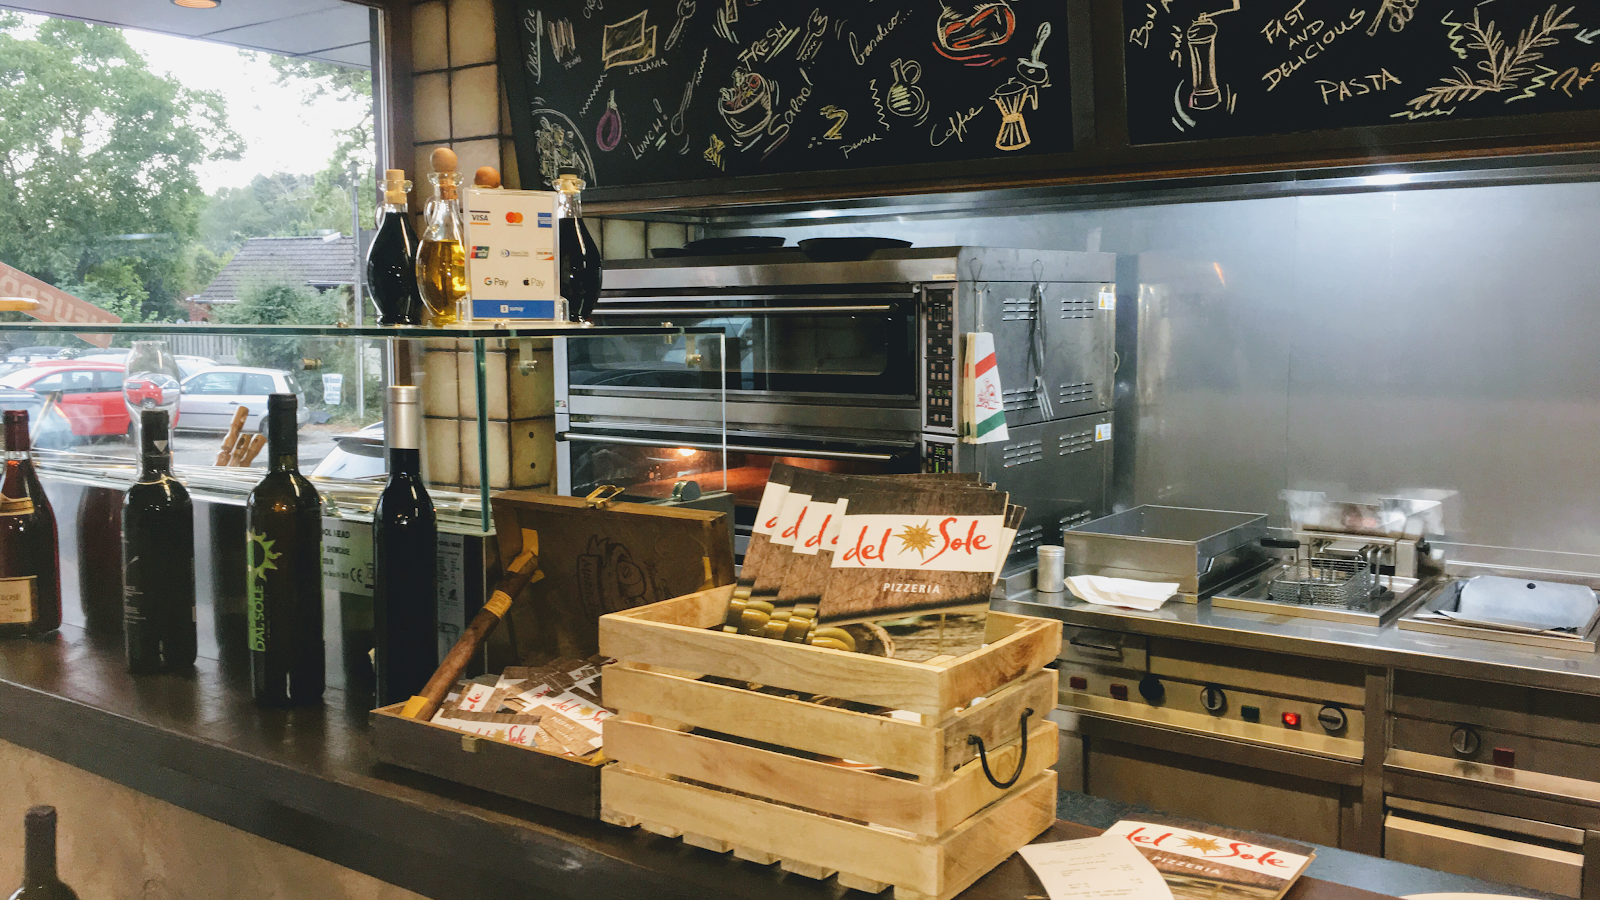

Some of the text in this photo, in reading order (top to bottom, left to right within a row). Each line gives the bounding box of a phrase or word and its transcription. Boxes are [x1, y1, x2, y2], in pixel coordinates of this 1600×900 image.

[1260, 2, 1305, 44] FAST
[1289, 20, 1325, 50] AND
[737, 21, 788, 71] FRESH
[1262, 8, 1366, 92] DELICIOUS
[1314, 68, 1402, 105] PASTA
[471, 214, 489, 222] VISA
[494, 278, 509, 288] Pay
[531, 278, 546, 289] Pay
[842, 525, 893, 566] del
[920, 517, 993, 566] Sole
[882, 582, 941, 594] PIZZERIA
[551, 699, 582, 713] del
[1152, 855, 1222, 876] PIZZERIA
[1202, 842, 1291, 869] Sole
